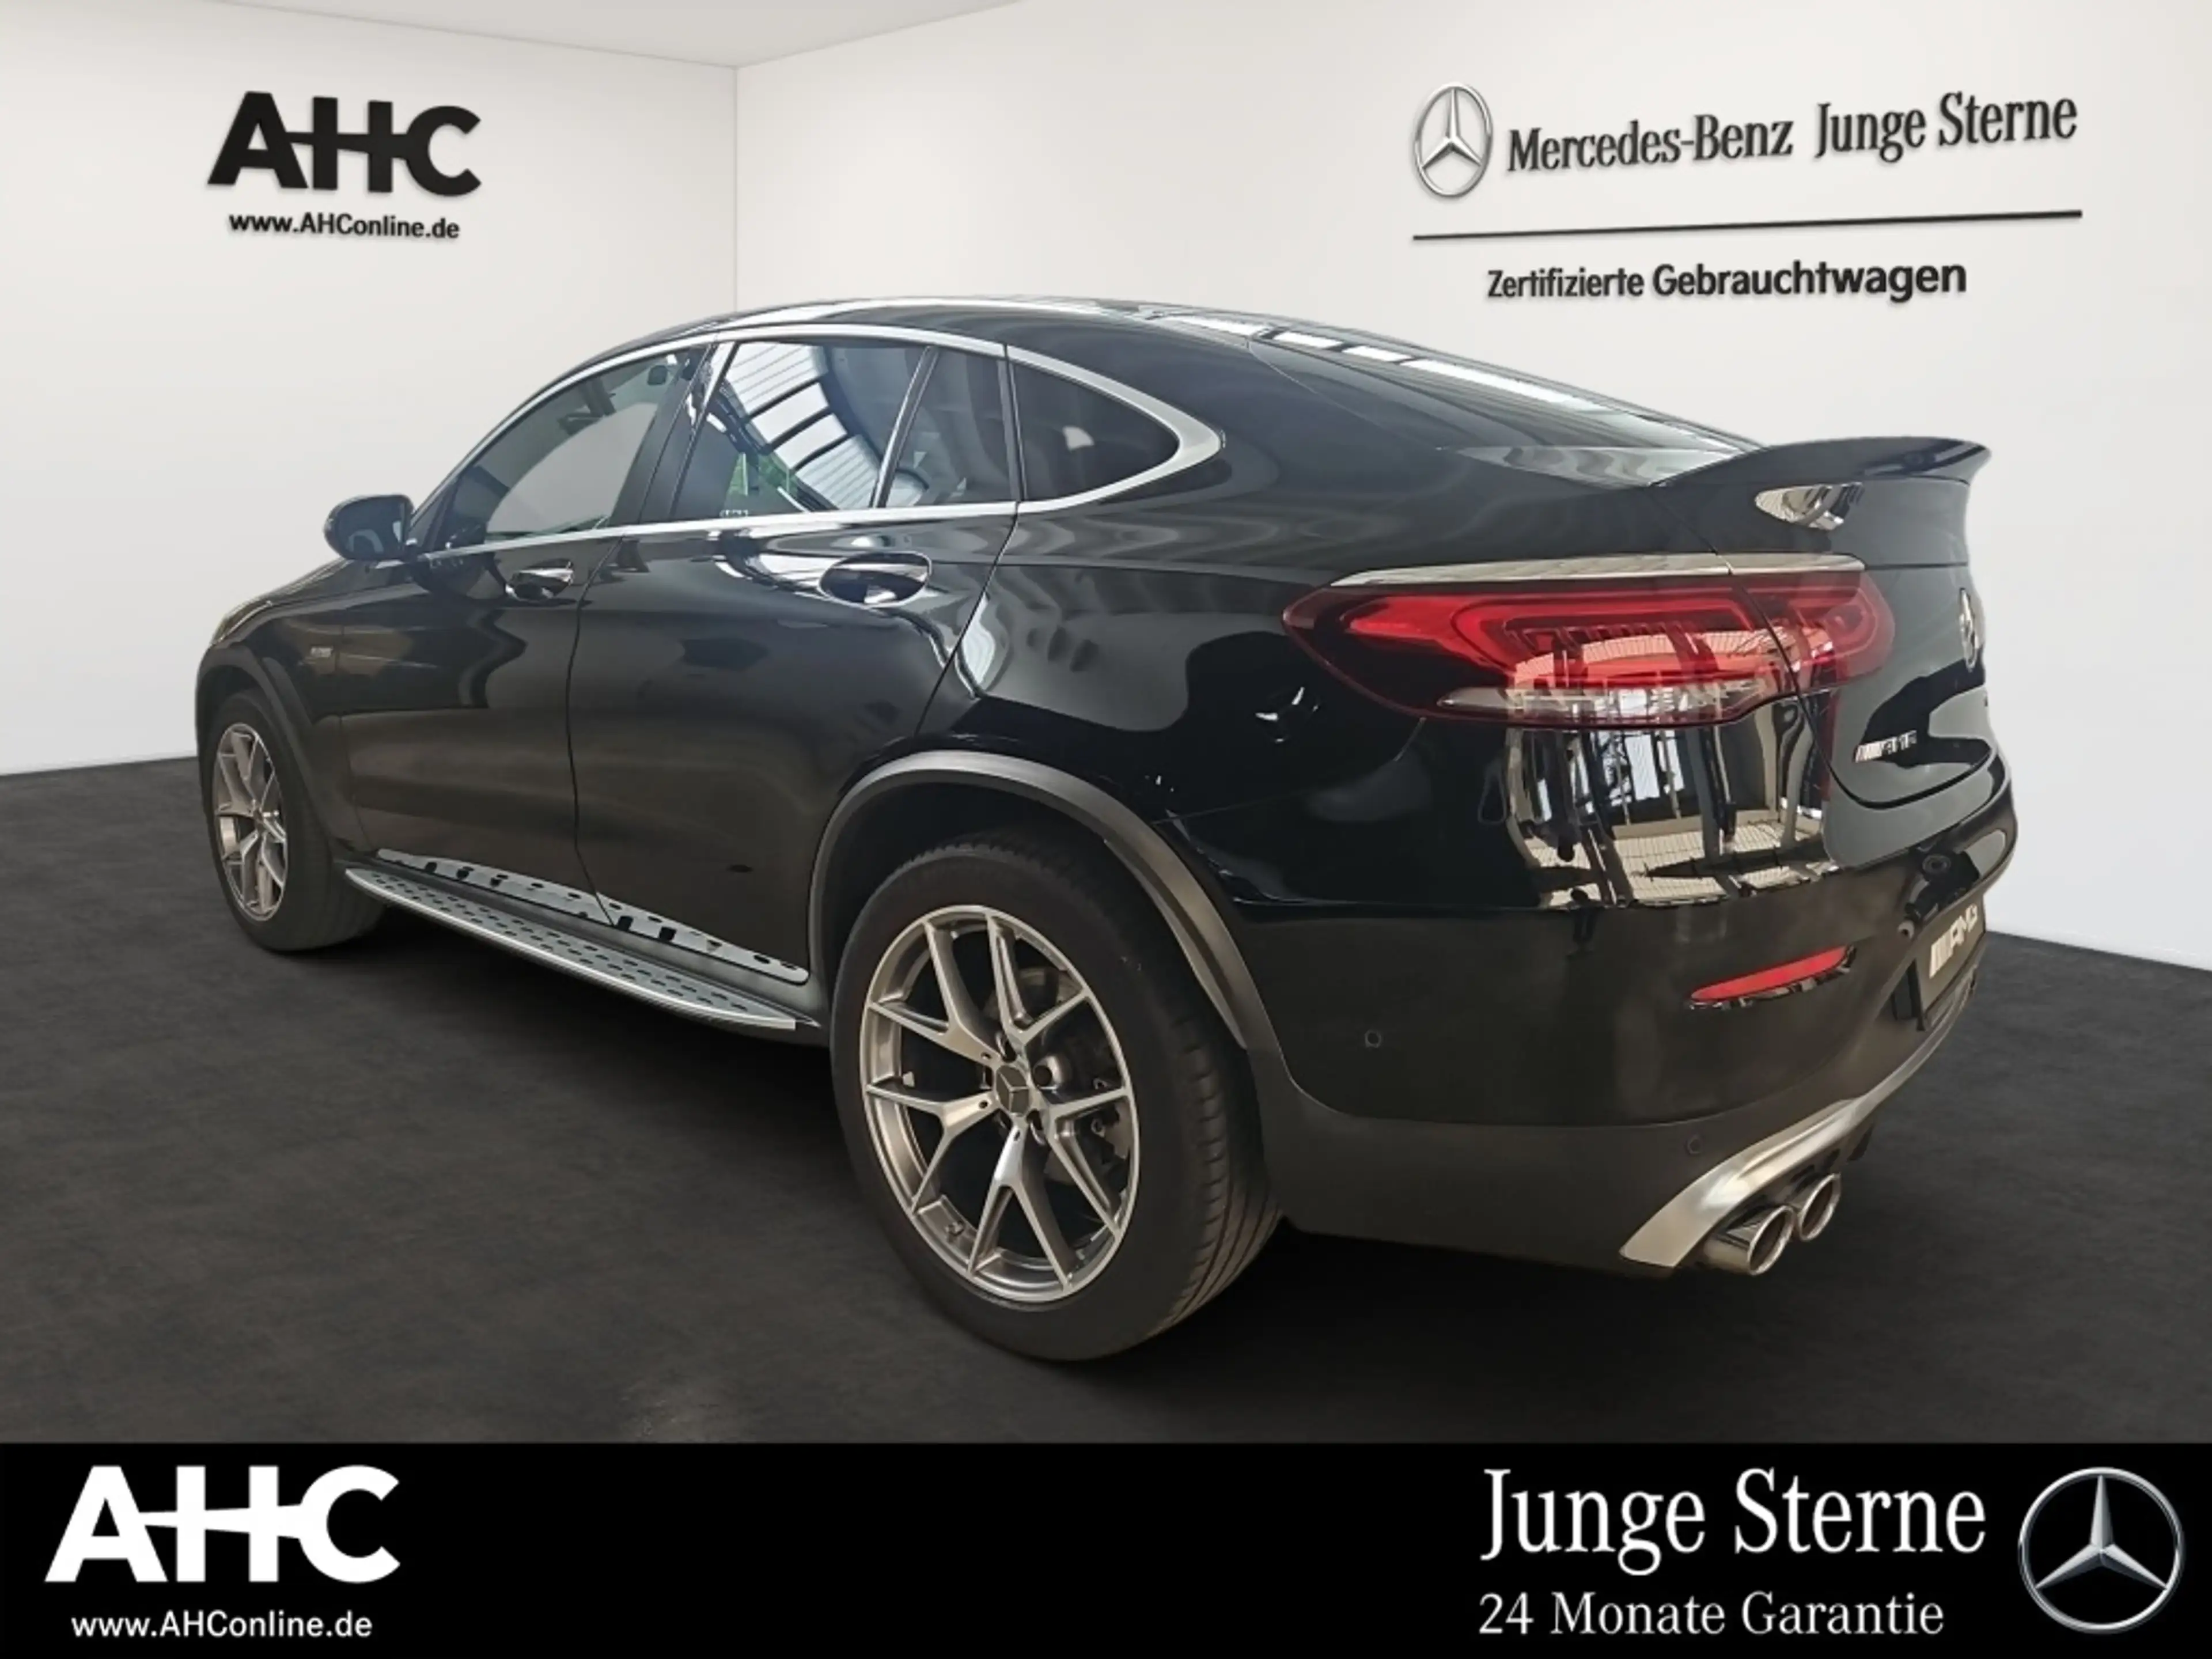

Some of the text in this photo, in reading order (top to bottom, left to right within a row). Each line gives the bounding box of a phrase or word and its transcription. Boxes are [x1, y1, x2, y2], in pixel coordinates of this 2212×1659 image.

[207, 90, 482, 197] AHC
[1508, 91, 2078, 172] Mercedes-Benz Junge Sterne
[229, 211, 460, 239] www.AHConline.de
[1487, 260, 1967, 304] Zertifizierte Gebrauchtwagen
